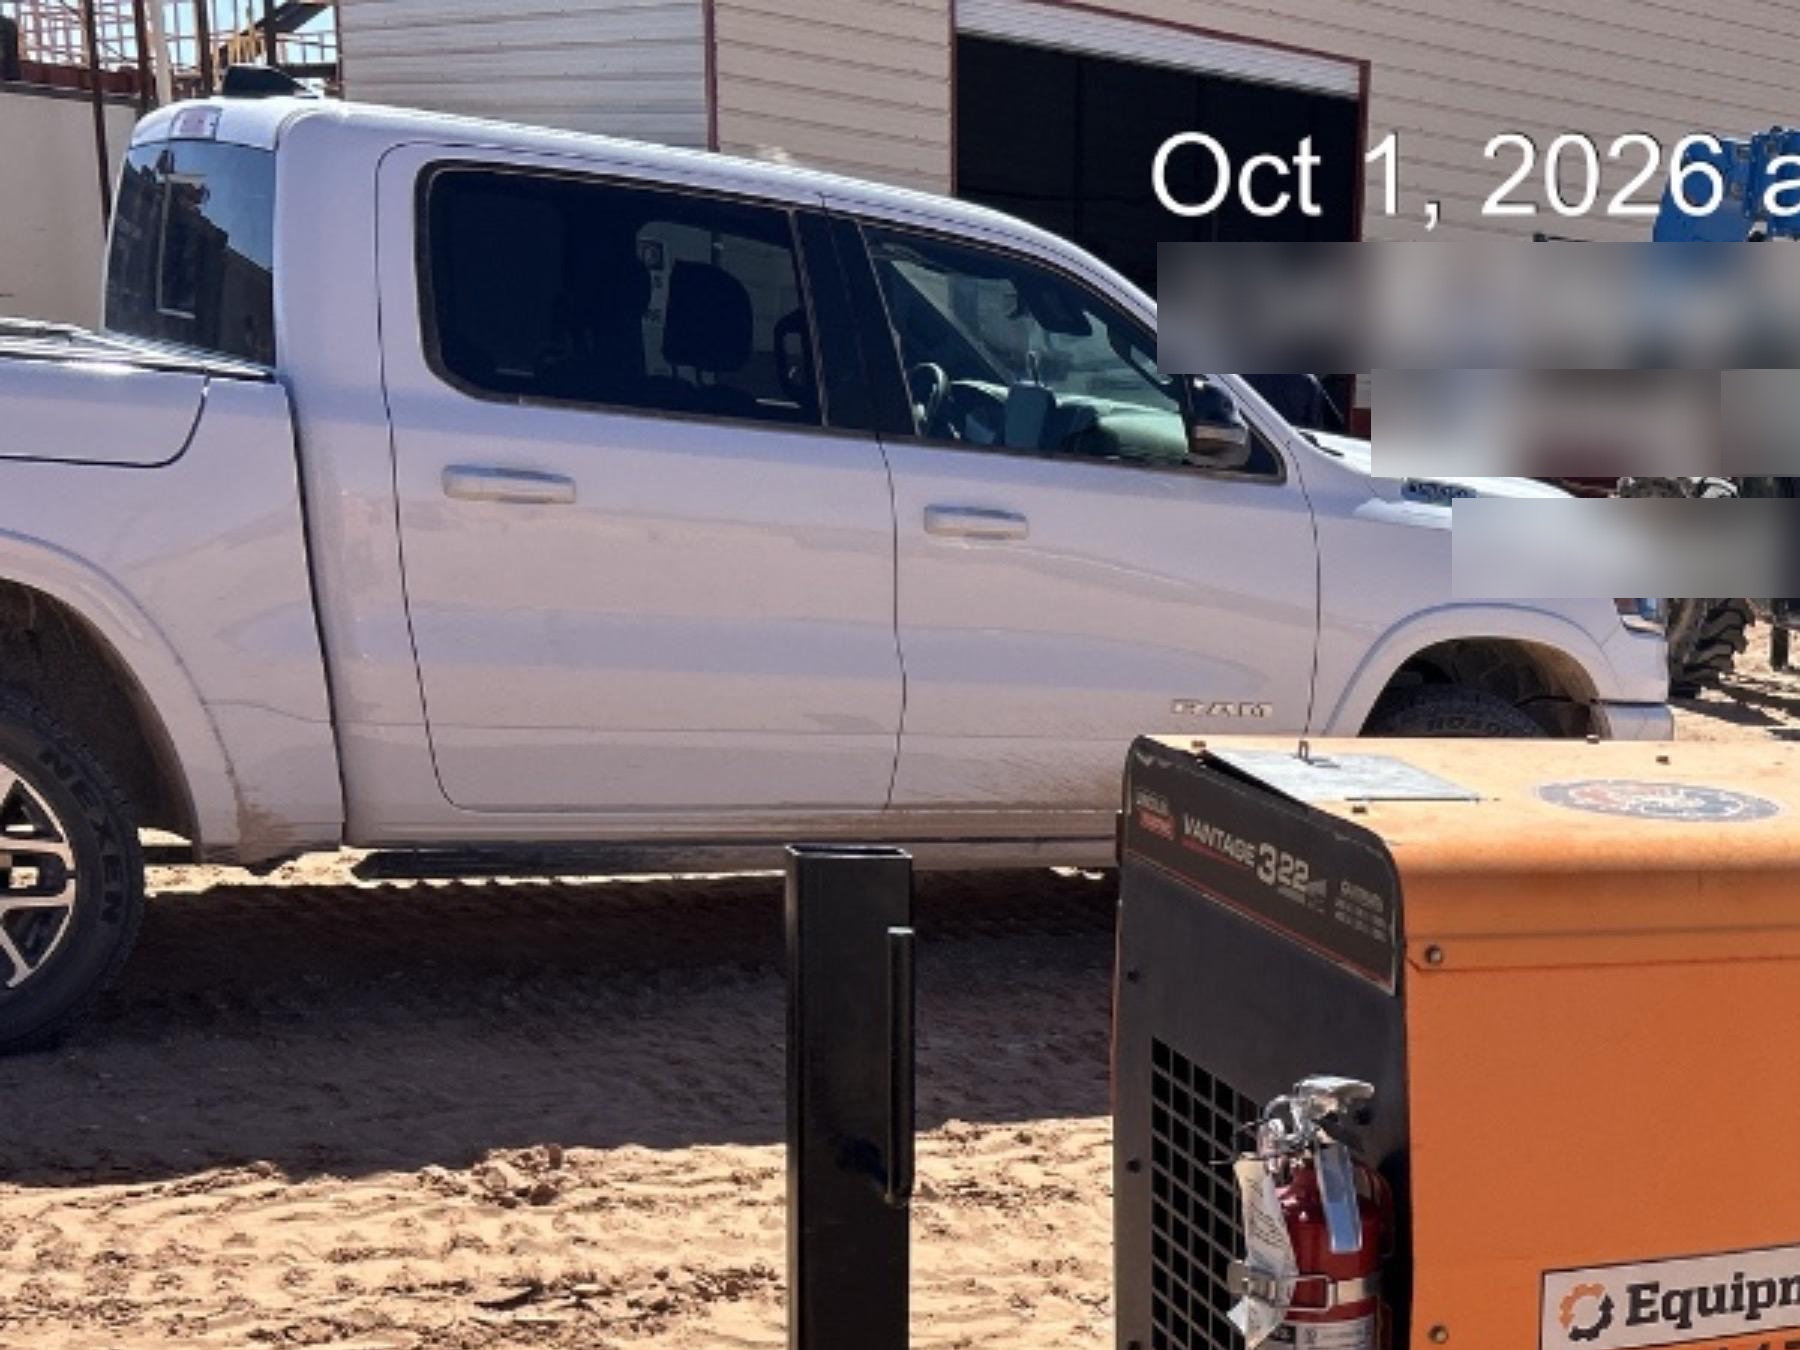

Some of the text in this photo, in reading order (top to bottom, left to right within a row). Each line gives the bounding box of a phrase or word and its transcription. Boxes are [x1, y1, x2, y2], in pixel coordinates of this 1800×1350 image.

[1170, 699, 1274, 719] RAM
[37, 746, 124, 926] NEXEN
[1183, 812, 1256, 868] VANTAGE
[1256, 841, 1310, 893] 322
